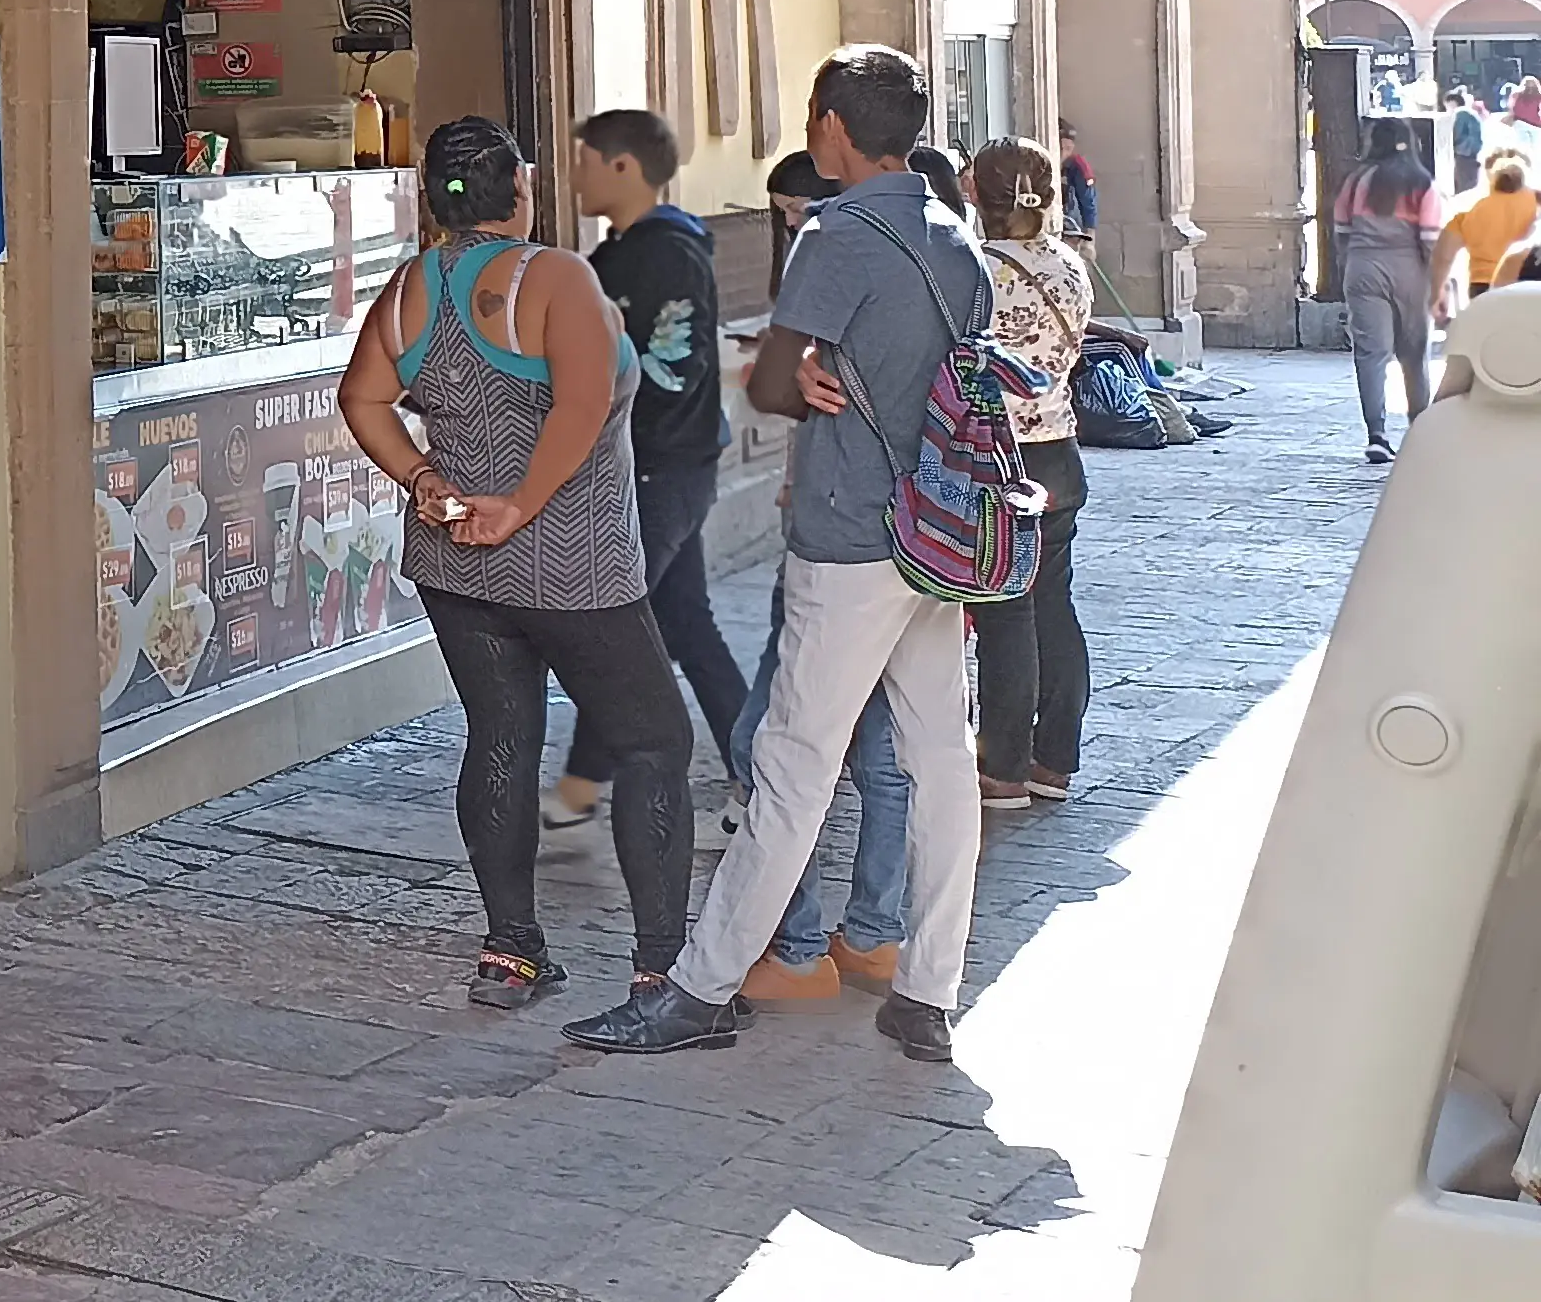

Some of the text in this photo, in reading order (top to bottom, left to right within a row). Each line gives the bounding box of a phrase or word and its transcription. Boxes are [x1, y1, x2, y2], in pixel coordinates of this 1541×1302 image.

[255, 386, 338, 430] SUPER FAST
[138, 411, 198, 448] HUEVOS
[305, 454, 332, 483] BOX
[214, 565, 269, 602] NESPRESSO
